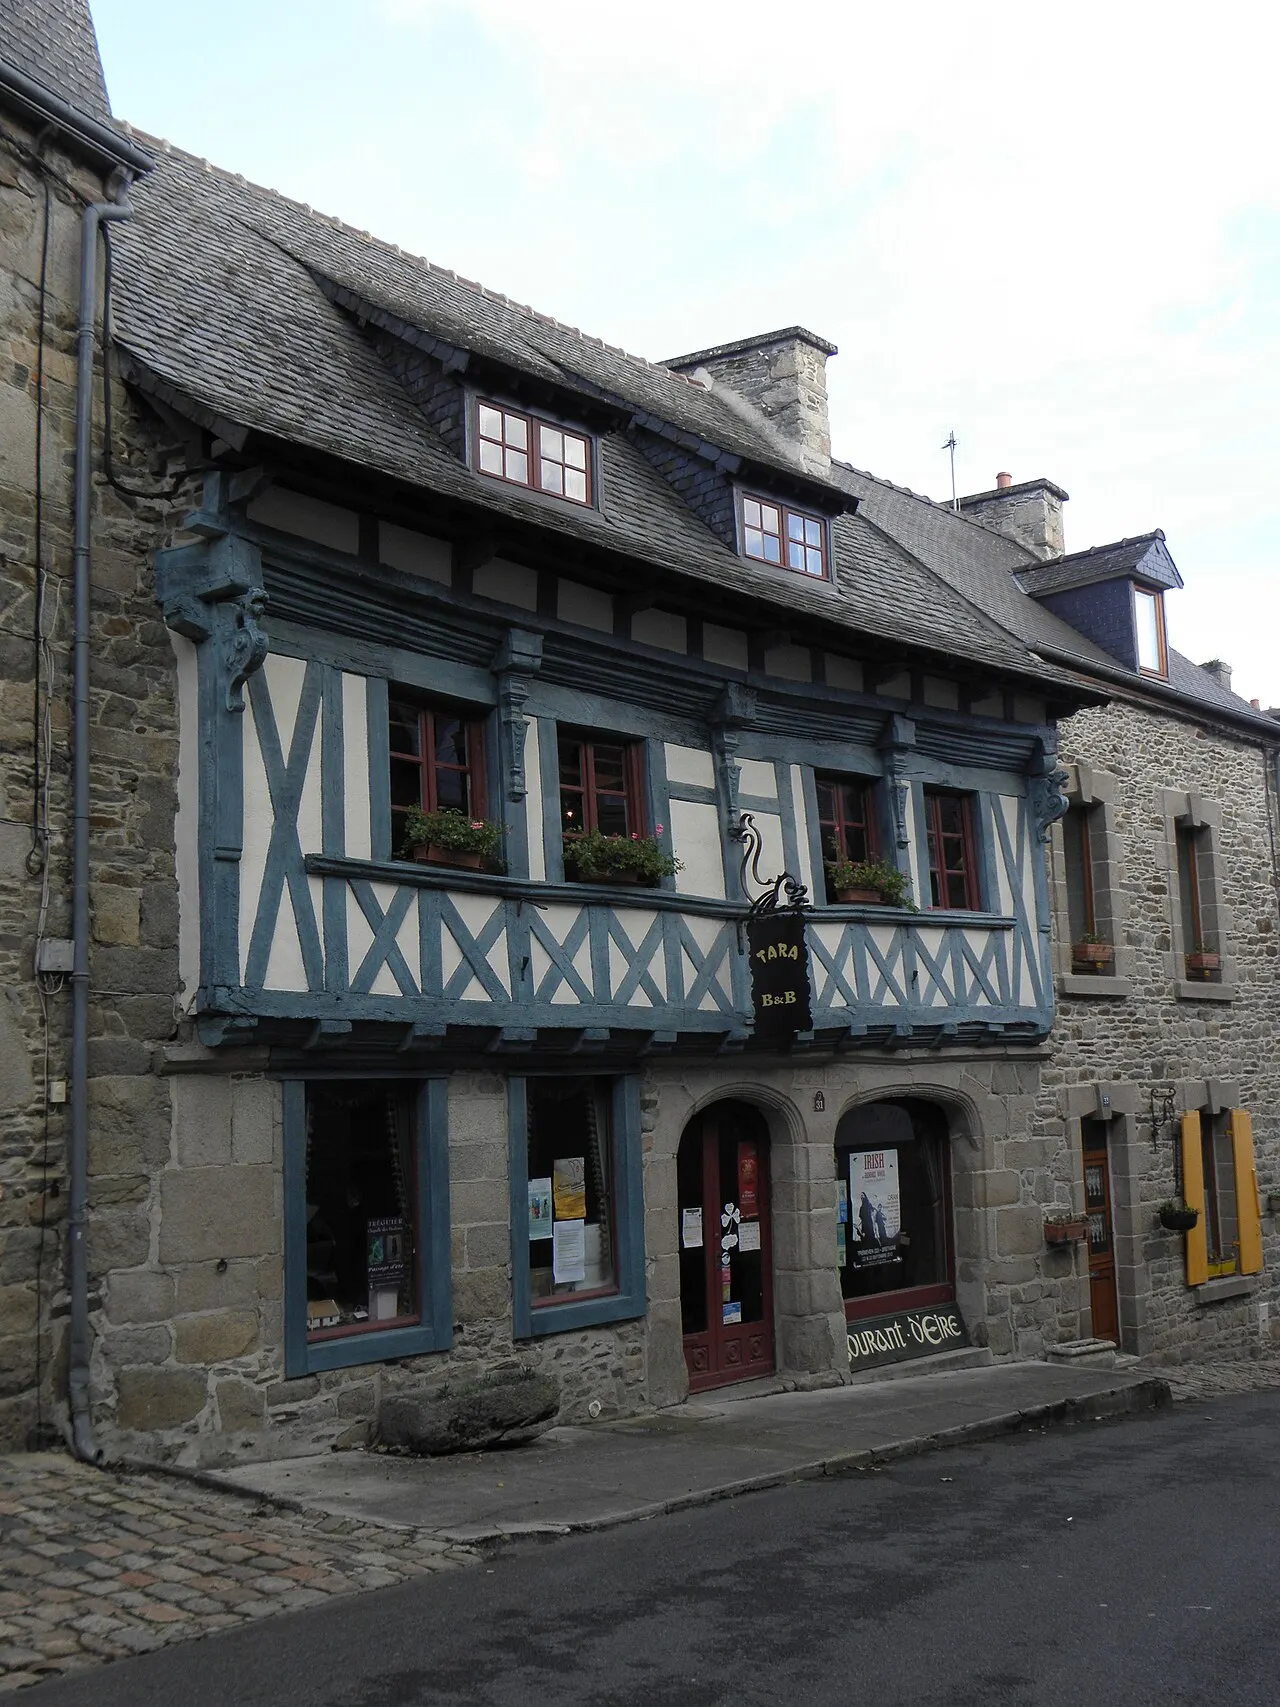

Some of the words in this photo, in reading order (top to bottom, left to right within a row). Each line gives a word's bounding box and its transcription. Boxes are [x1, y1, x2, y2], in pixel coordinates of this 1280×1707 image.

[756, 943, 798, 963] TARA
[761, 991, 796, 1007] B&B
[864, 1153, 884, 1170] IRISH
